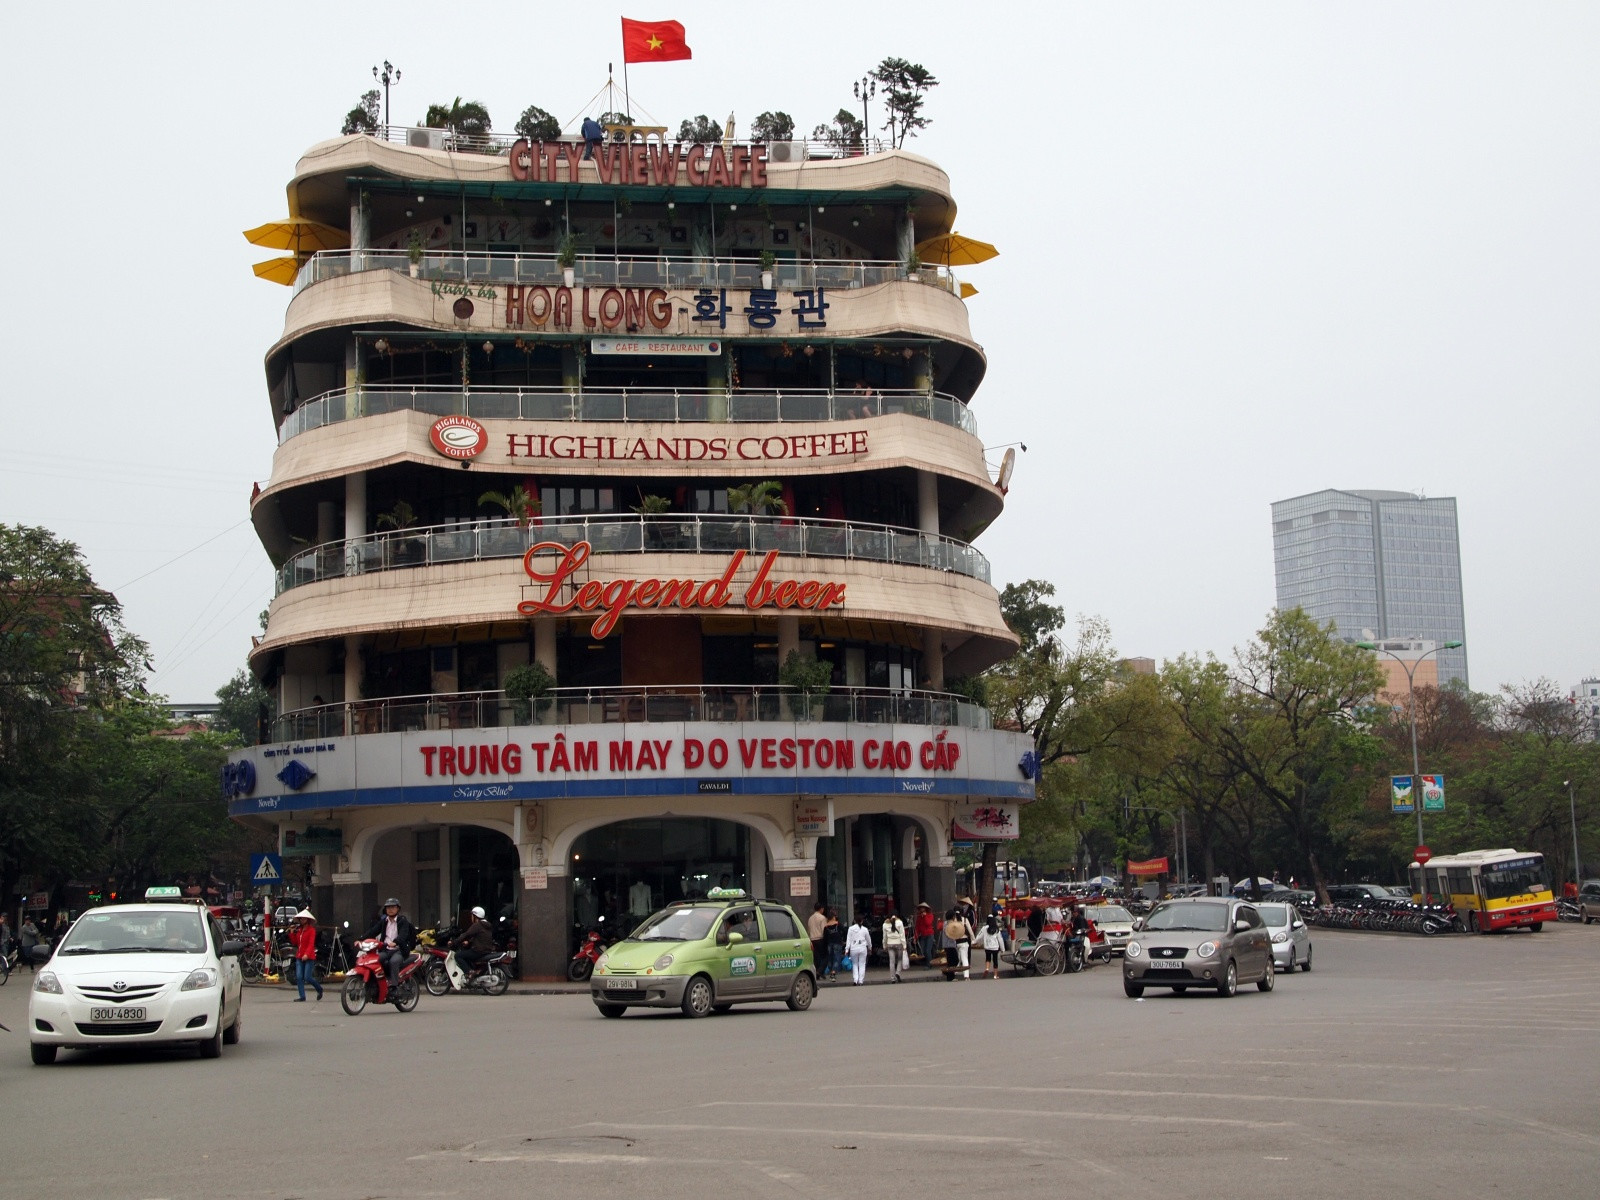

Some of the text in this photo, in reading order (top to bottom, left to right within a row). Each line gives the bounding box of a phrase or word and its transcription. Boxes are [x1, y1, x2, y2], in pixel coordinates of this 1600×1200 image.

[509, 138, 768, 188] CITY VIEW CAFE
[506, 285, 573, 328] HOA
[582, 285, 673, 330] LONG
[648, 343, 705, 353] RESTAURANT
[435, 417, 482, 433] HIGHLANDS
[445, 446, 477, 457] COFFEE
[506, 430, 869, 461] HIGHLANDS COFFEE
[517, 540, 847, 640] Legend beer
[420, 729, 961, 776] TRUNG TÂM MAY ĐO VESTON CAO CẤP
[453, 787, 483, 801] Navy
[699, 783, 730, 791] CAVALDI
[149, 887, 177, 896] TAXI
[94, 1008, 143, 1019] 30U-4830
